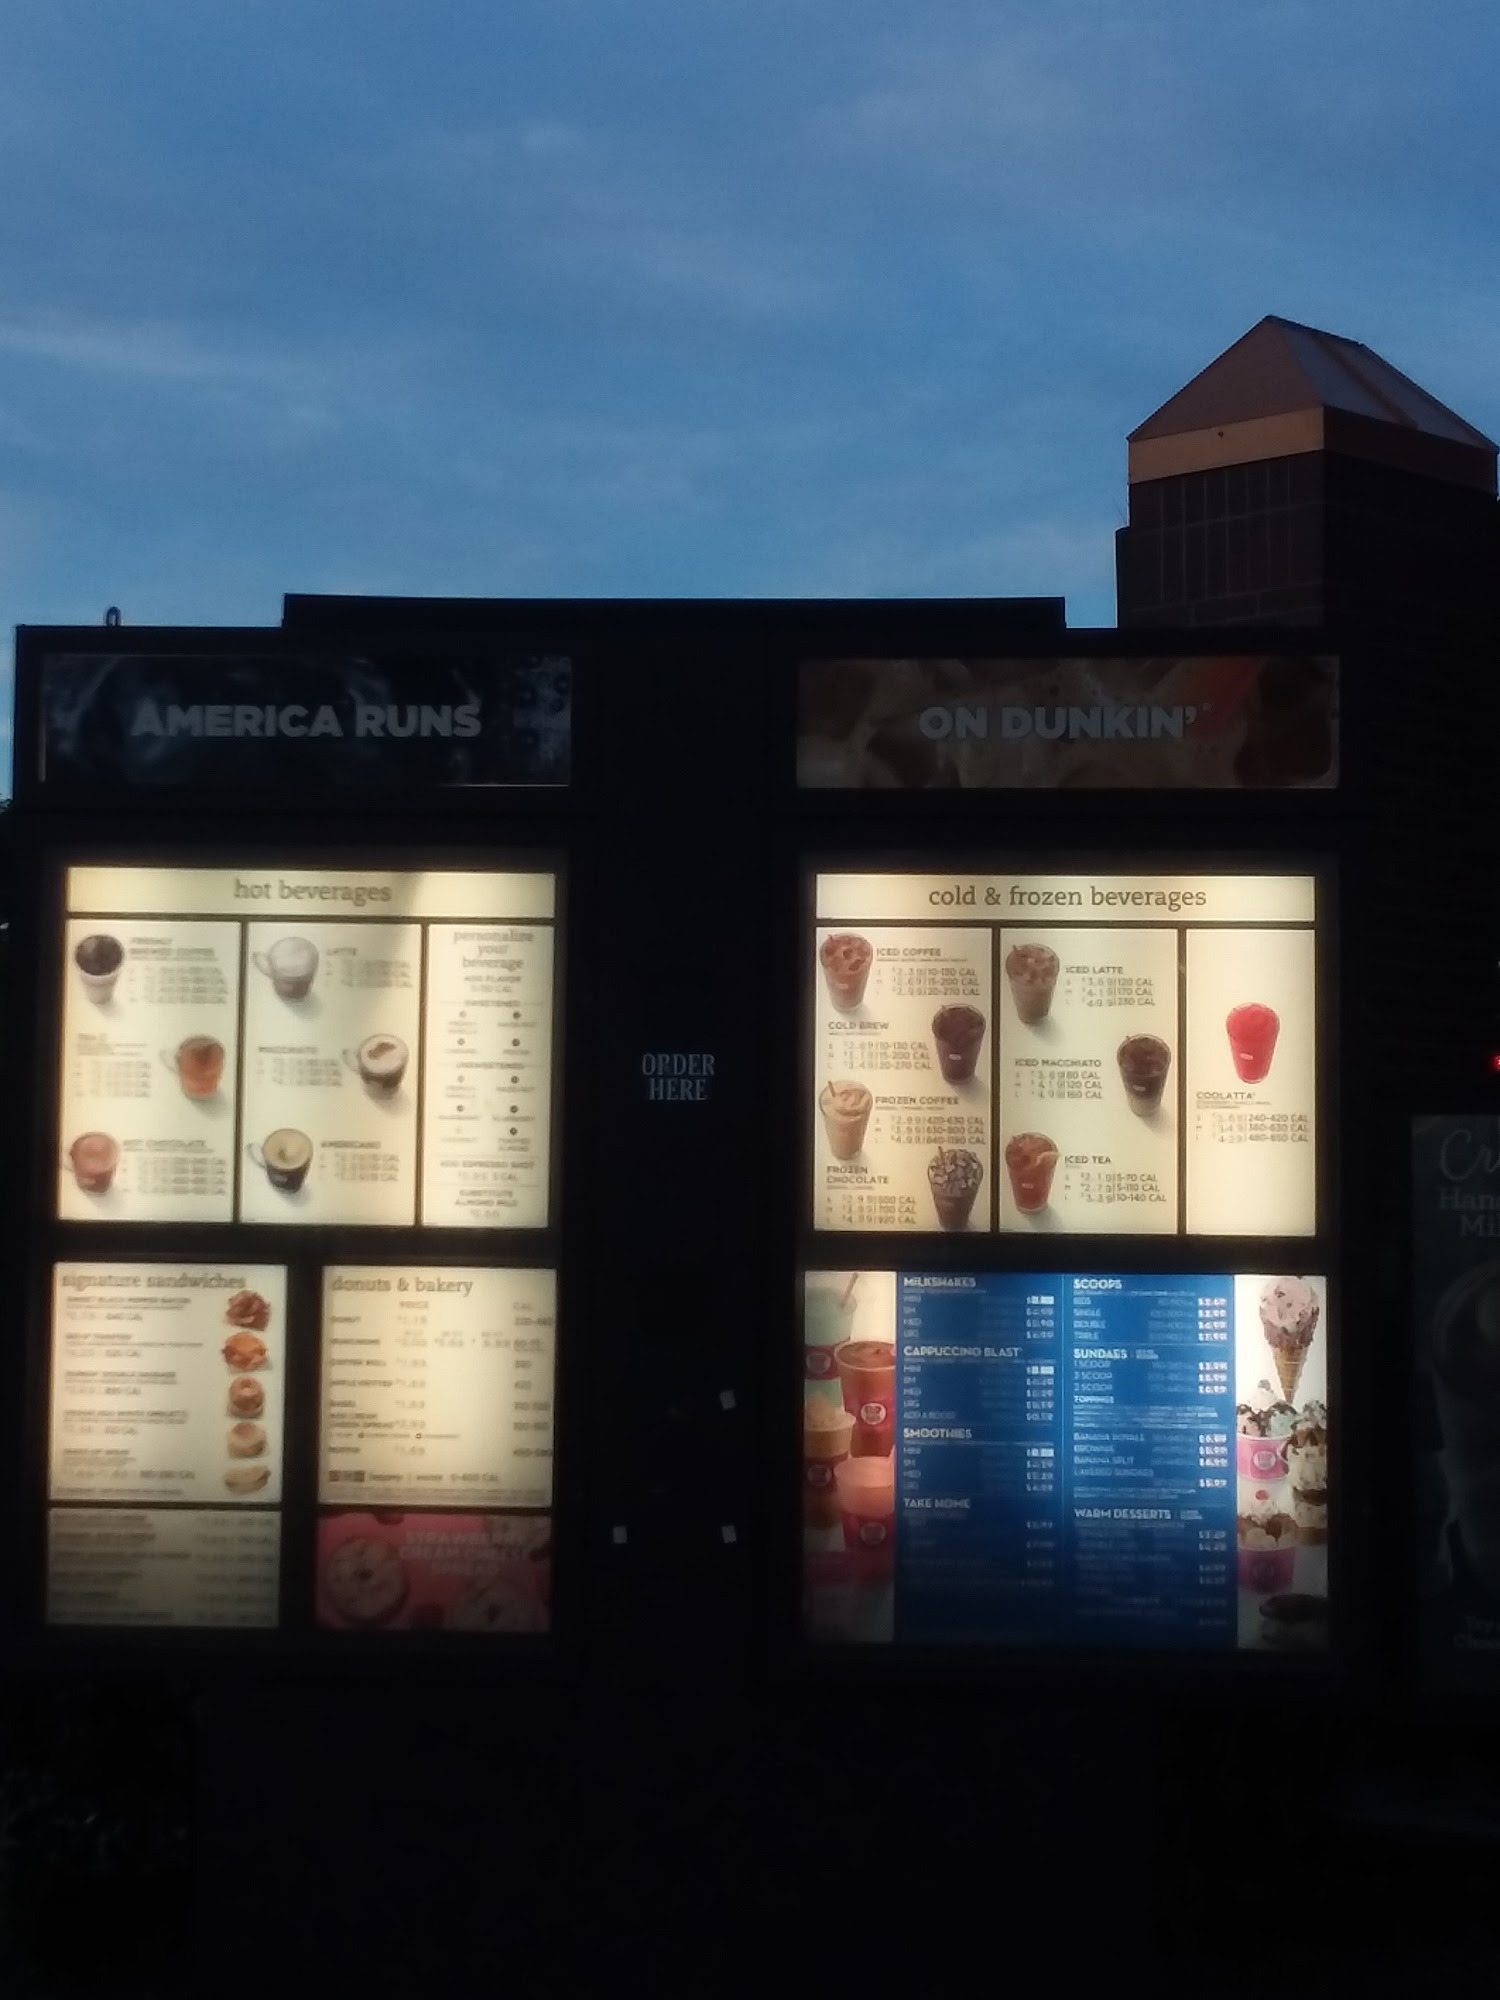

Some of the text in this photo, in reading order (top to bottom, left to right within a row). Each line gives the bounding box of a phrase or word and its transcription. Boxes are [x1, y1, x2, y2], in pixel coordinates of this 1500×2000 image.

[130, 704, 482, 737] AMERICA RUNS
[918, 706, 1197, 739] ON DUNKIN'
[234, 878, 393, 907] hot beverages
[929, 885, 1207, 912] cold & frozen beverages
[876, 948, 942, 957] ICED COFFEE
[1065, 966, 1124, 975] ICED LATTE
[828, 1021, 889, 1030] COLD BREW
[642, 1053, 716, 1076] ORDER
[1015, 1058, 1102, 1068] ICED MACCHIATO
[648, 1077, 708, 1101] HERE
[875, 1096, 960, 1105] FROZEN COFFEE
[1064, 1155, 1112, 1164] ICED TEA
[827, 1165, 868, 1174] FROZEN
[826, 1175, 889, 1184] CHOCOLATE
[332, 1276, 473, 1297] donuts & bakery
[1073, 1279, 1122, 1289] SCOOPS
[904, 1346, 1020, 1357] CAPPUCCINO BLAST
[1074, 1348, 1127, 1359] SUNDAES
[904, 1428, 972, 1439] SMOOTHIES
[904, 1498, 972, 1509] TAKE HOME
[1074, 1508, 1171, 1520] WARM DESSERTS
